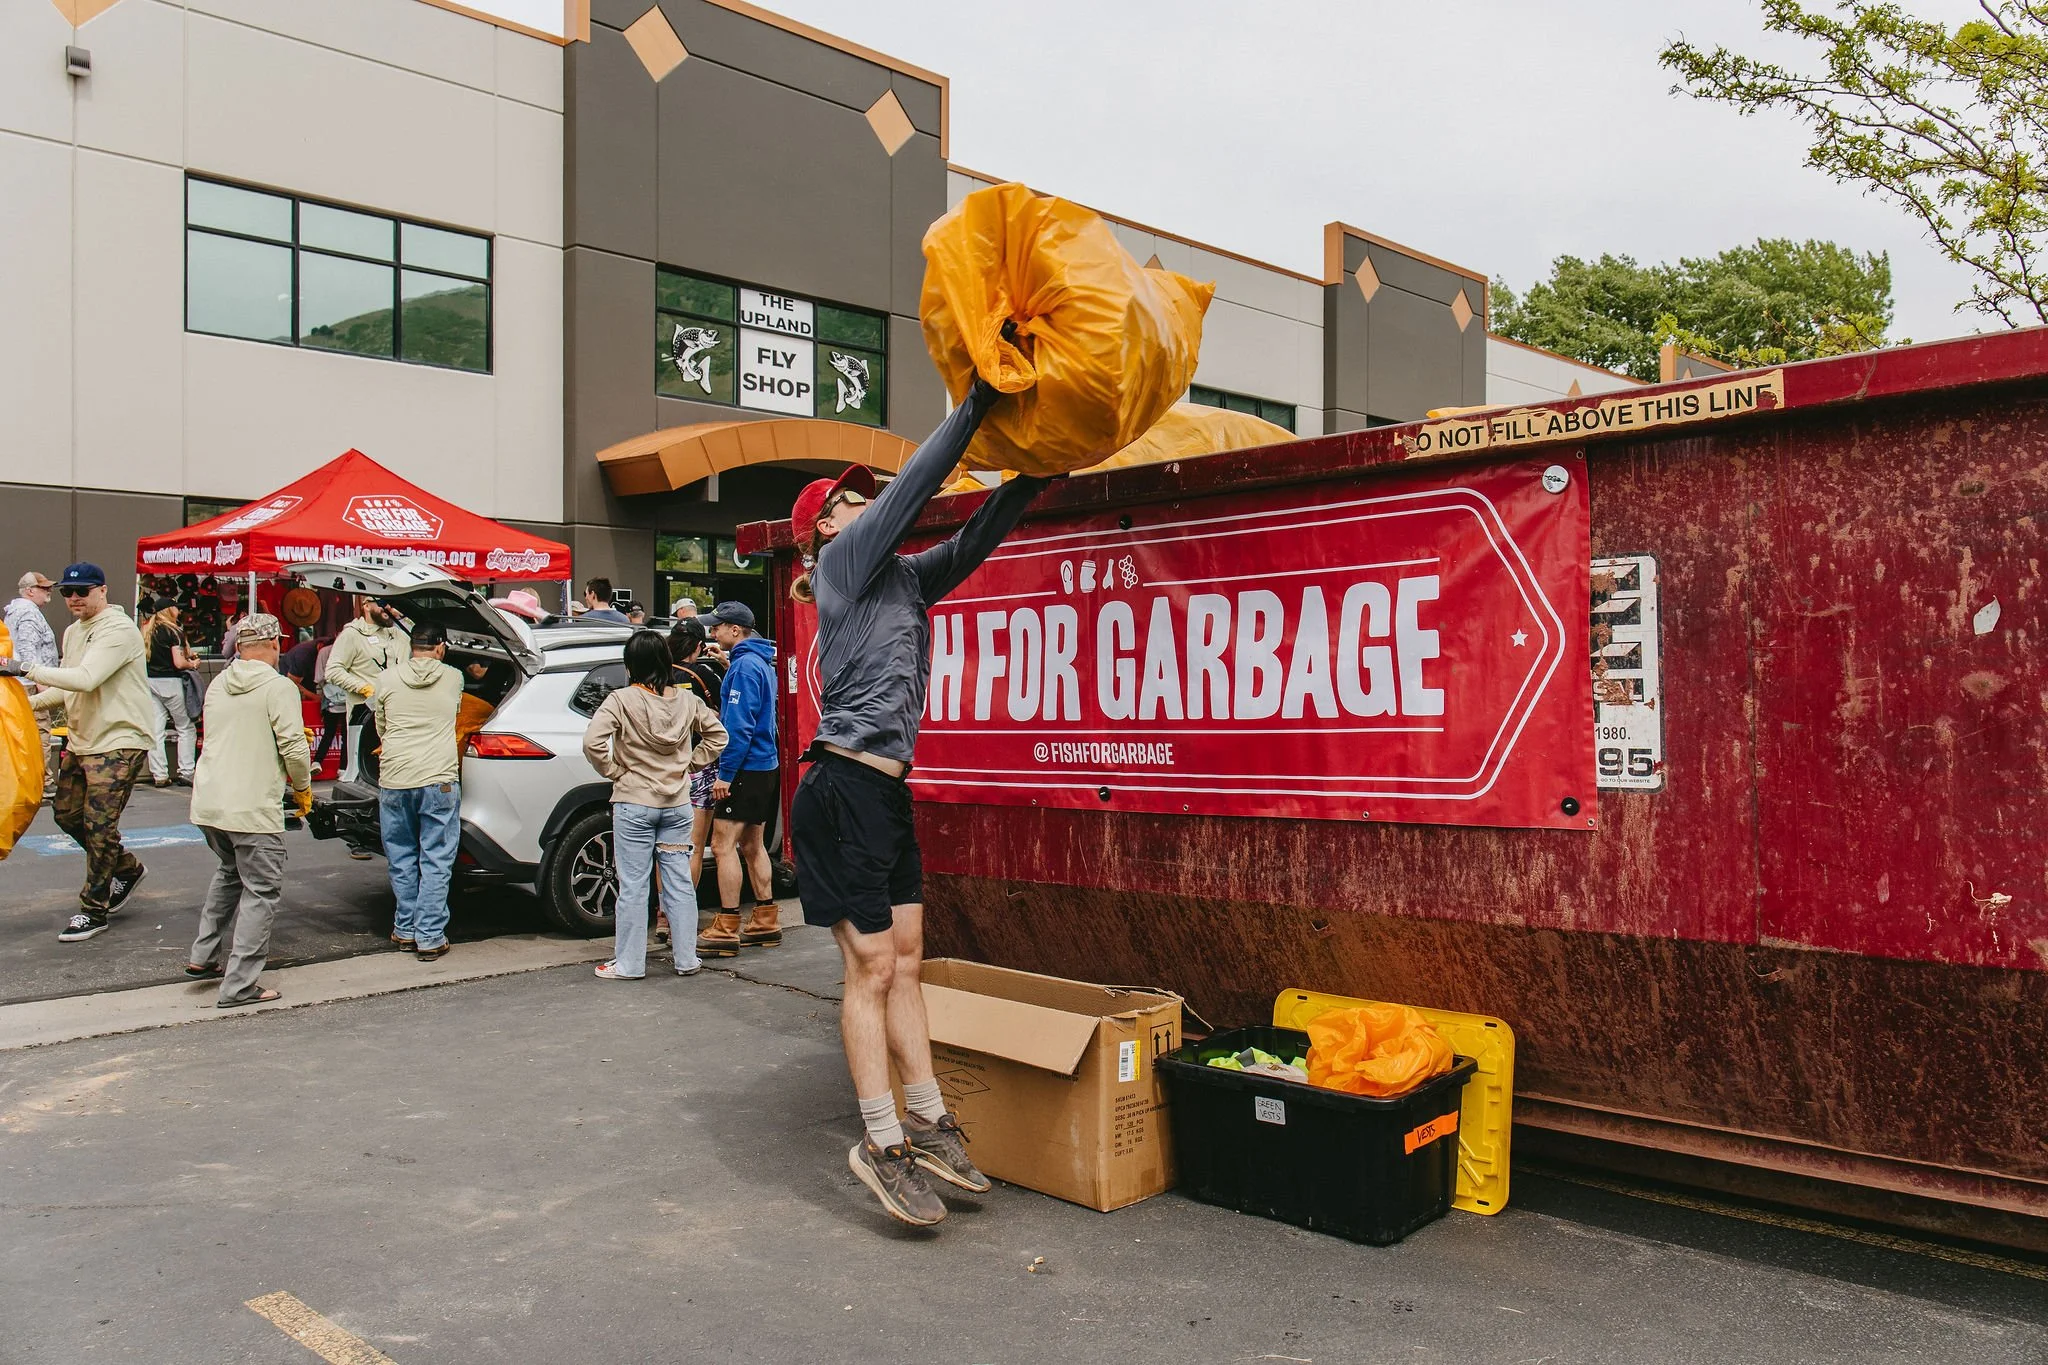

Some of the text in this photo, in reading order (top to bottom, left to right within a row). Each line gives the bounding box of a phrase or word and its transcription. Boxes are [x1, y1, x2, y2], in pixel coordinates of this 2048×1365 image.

[759, 293, 794, 312] THE
[741, 310, 812, 335] UPLAND
[757, 347, 797, 369] FLY
[743, 373, 811, 398] SHOP
[1416, 432, 1432, 451] O
[1439, 425, 1484, 449] NOT
[1492, 419, 1541, 442] FILL
[1546, 404, 1634, 436] ABOVE
[1638, 394, 1700, 421] THIS
[355, 508, 423, 520] FISH FOR
[362, 519, 434, 531] GARBAGE
[974, 604, 1081, 721] FOR
[1097, 574, 1445, 721] GARBAGE
[1594, 726, 1631, 740] 1980.
[1034, 742, 1175, 765] @FISHFORGARBAGE
[1258, 1100, 1282, 1112] GREEN
[1260, 1109, 1281, 1121] VESTS
[1416, 1124, 1436, 1144] VESTS
